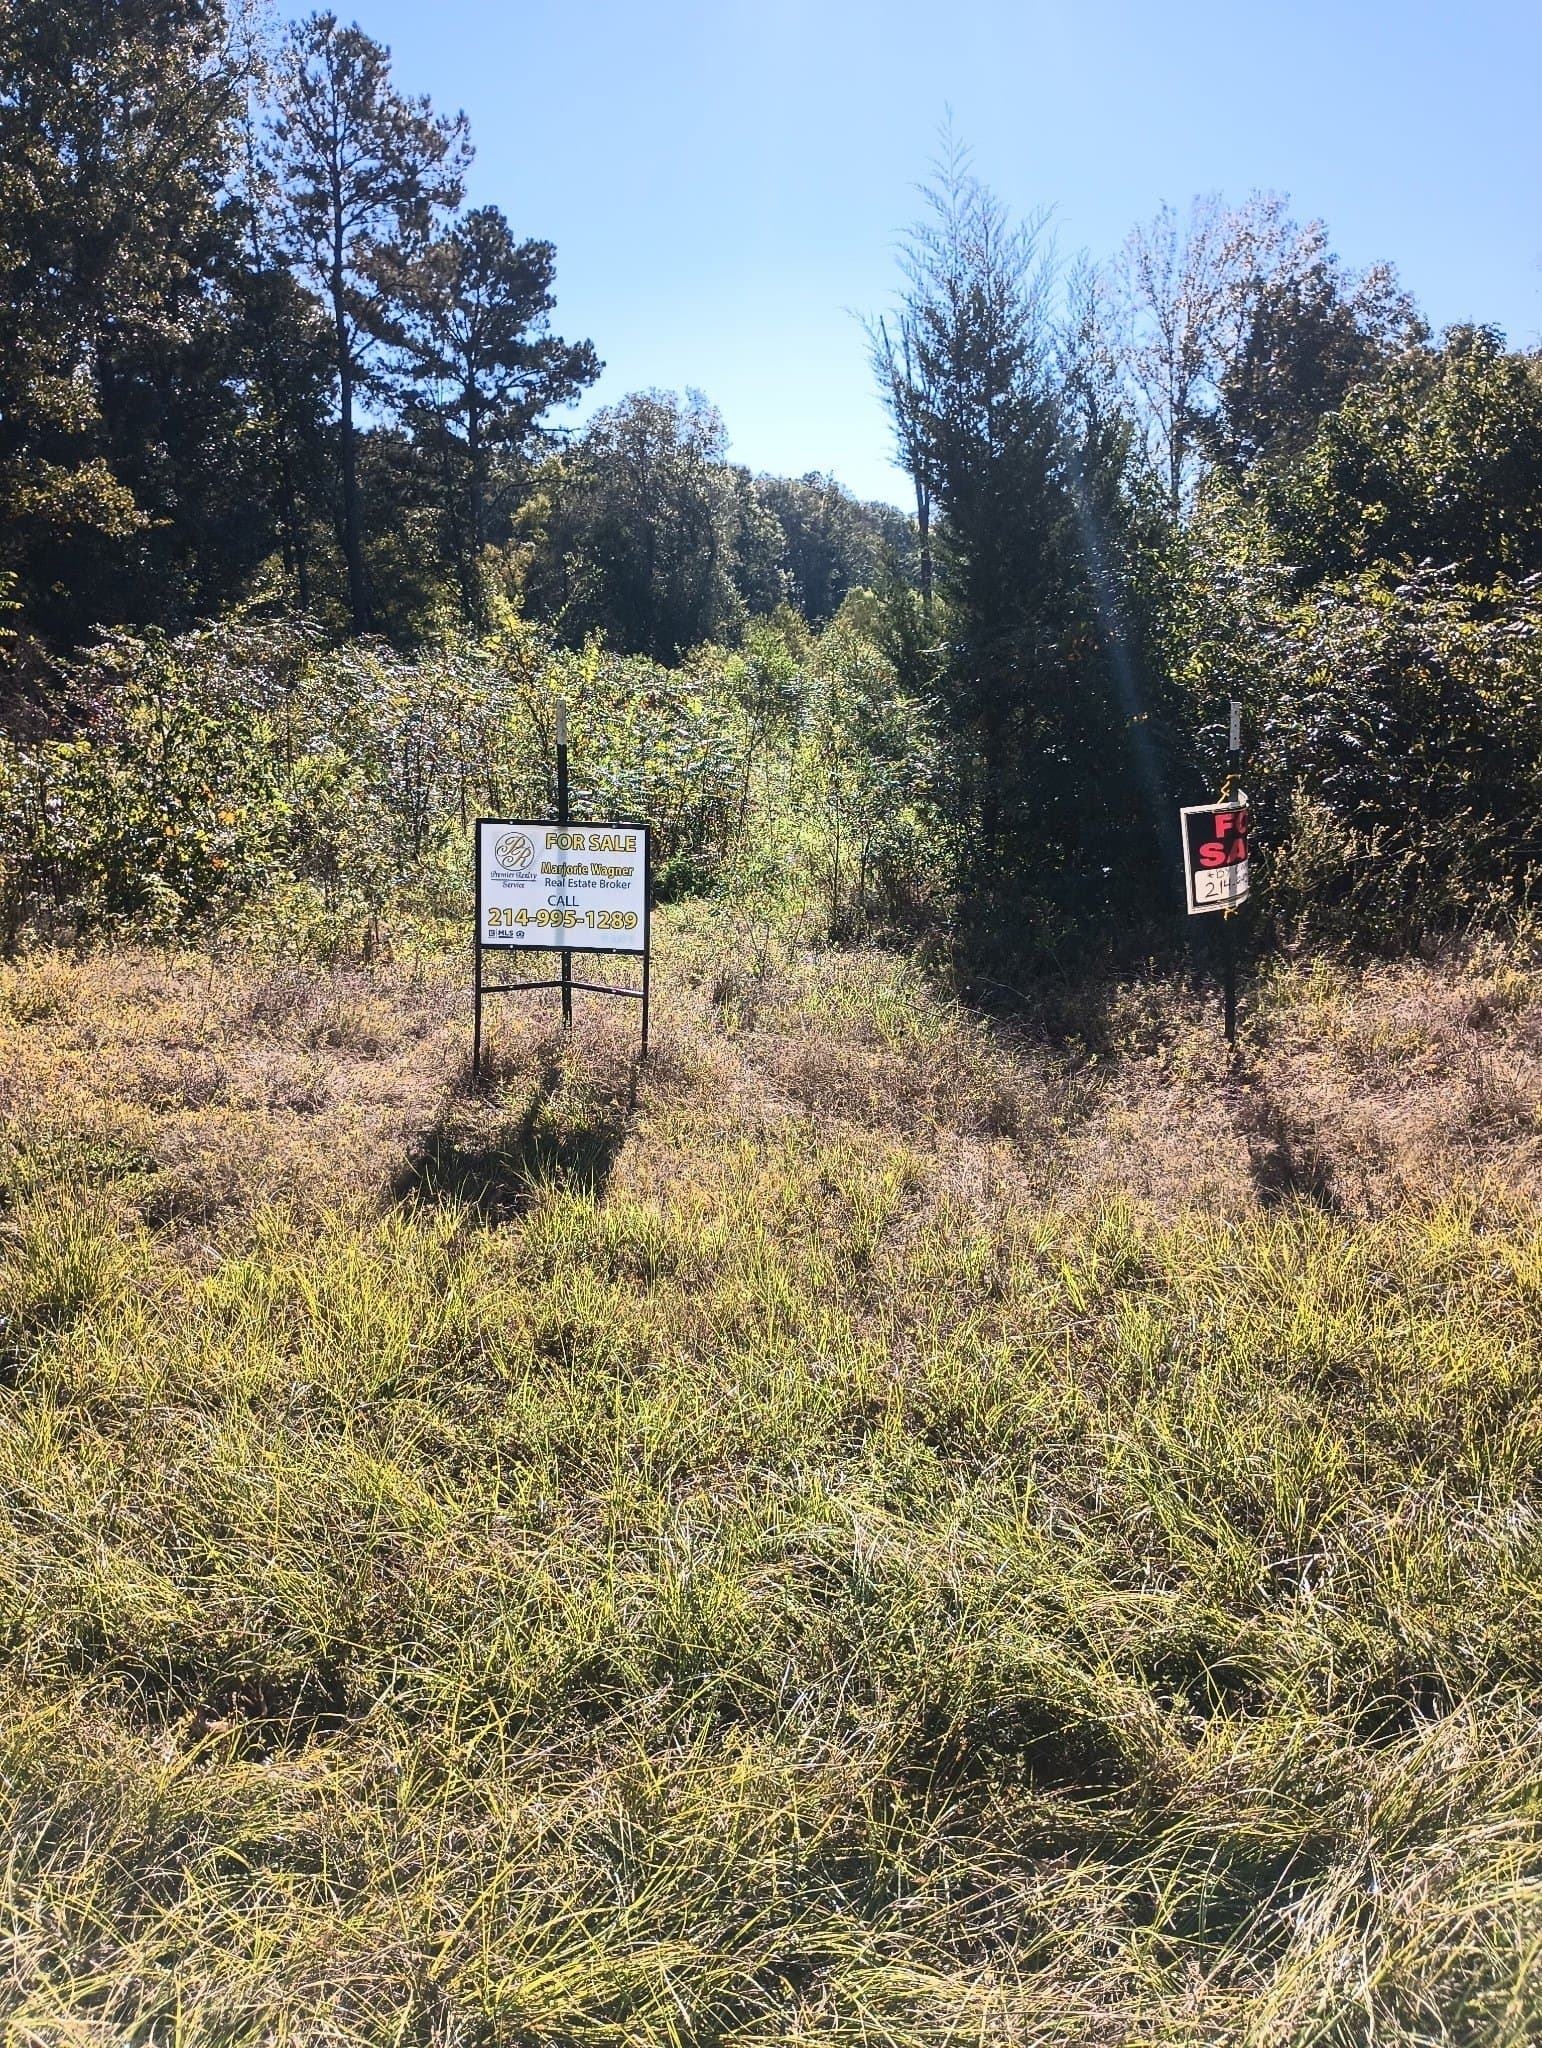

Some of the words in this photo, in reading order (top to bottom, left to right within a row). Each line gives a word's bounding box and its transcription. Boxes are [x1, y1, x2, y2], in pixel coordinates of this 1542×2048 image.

[546, 833, 585, 851] FOR
[589, 834, 637, 852] SALE
[541, 862, 588, 877] Marjorie
[590, 864, 634, 879] Wagner
[502, 881, 525, 889] Service
[544, 877, 566, 888] Real
[567, 878, 597, 889] Estate
[599, 879, 632, 890] Broker
[547, 895, 580, 907] CALL
[488, 907, 638, 930] 214-995-1289
